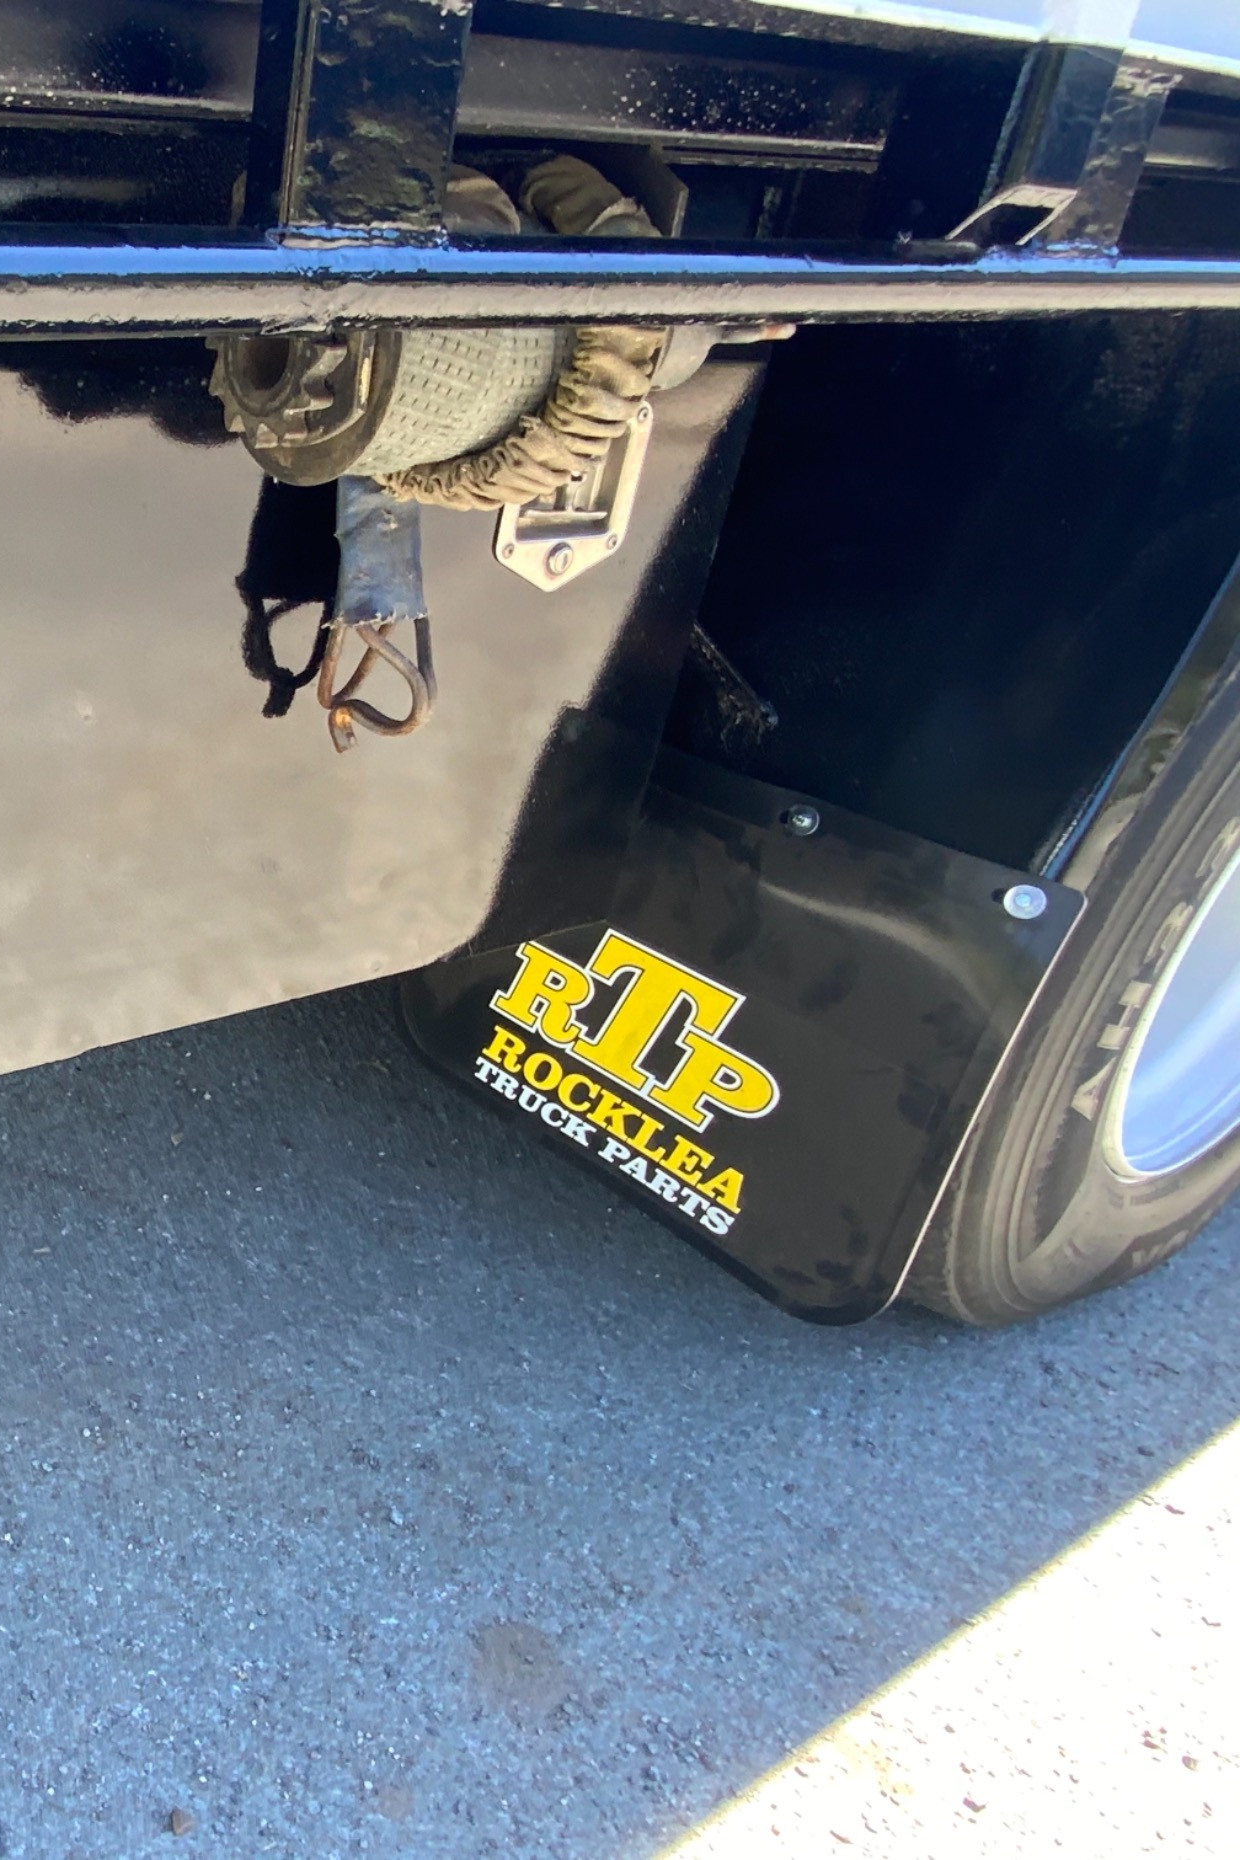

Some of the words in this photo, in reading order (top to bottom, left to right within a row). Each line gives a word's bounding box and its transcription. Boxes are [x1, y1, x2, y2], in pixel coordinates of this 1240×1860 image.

[482, 1026, 745, 1214] ROCKLEA
[489, 928, 780, 1133] RTP
[474, 1057, 597, 1147] TRUCK
[597, 1137, 735, 1236] PARTS
